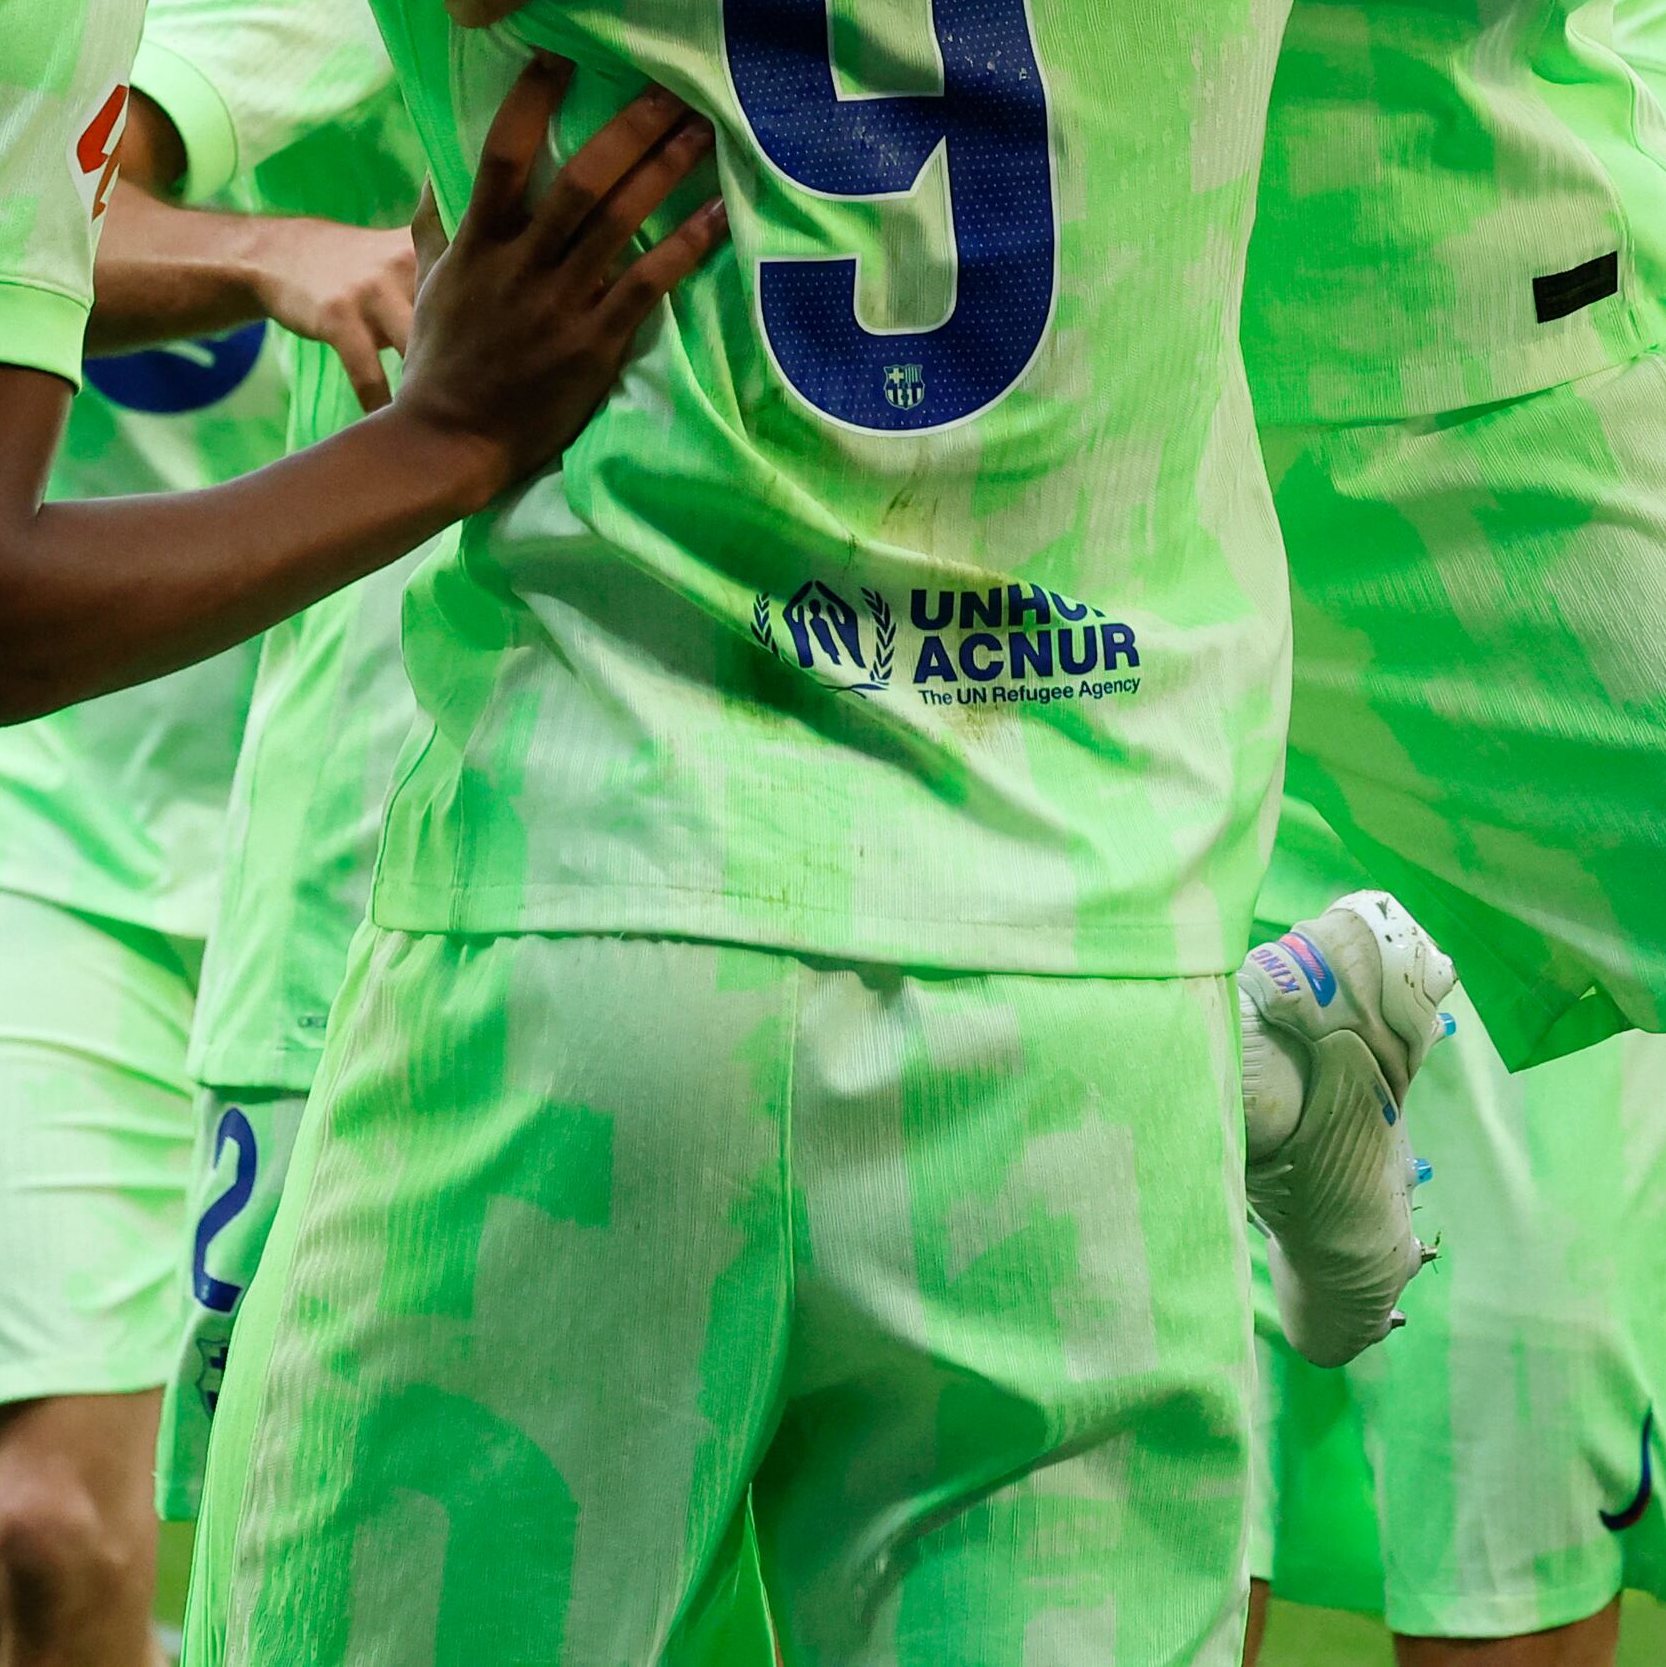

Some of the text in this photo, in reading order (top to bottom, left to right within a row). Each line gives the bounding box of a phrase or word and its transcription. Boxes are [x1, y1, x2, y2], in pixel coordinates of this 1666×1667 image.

[913, 622, 1141, 684] ACNUR
[918, 677, 1141, 705] The UN Refugee Agency
